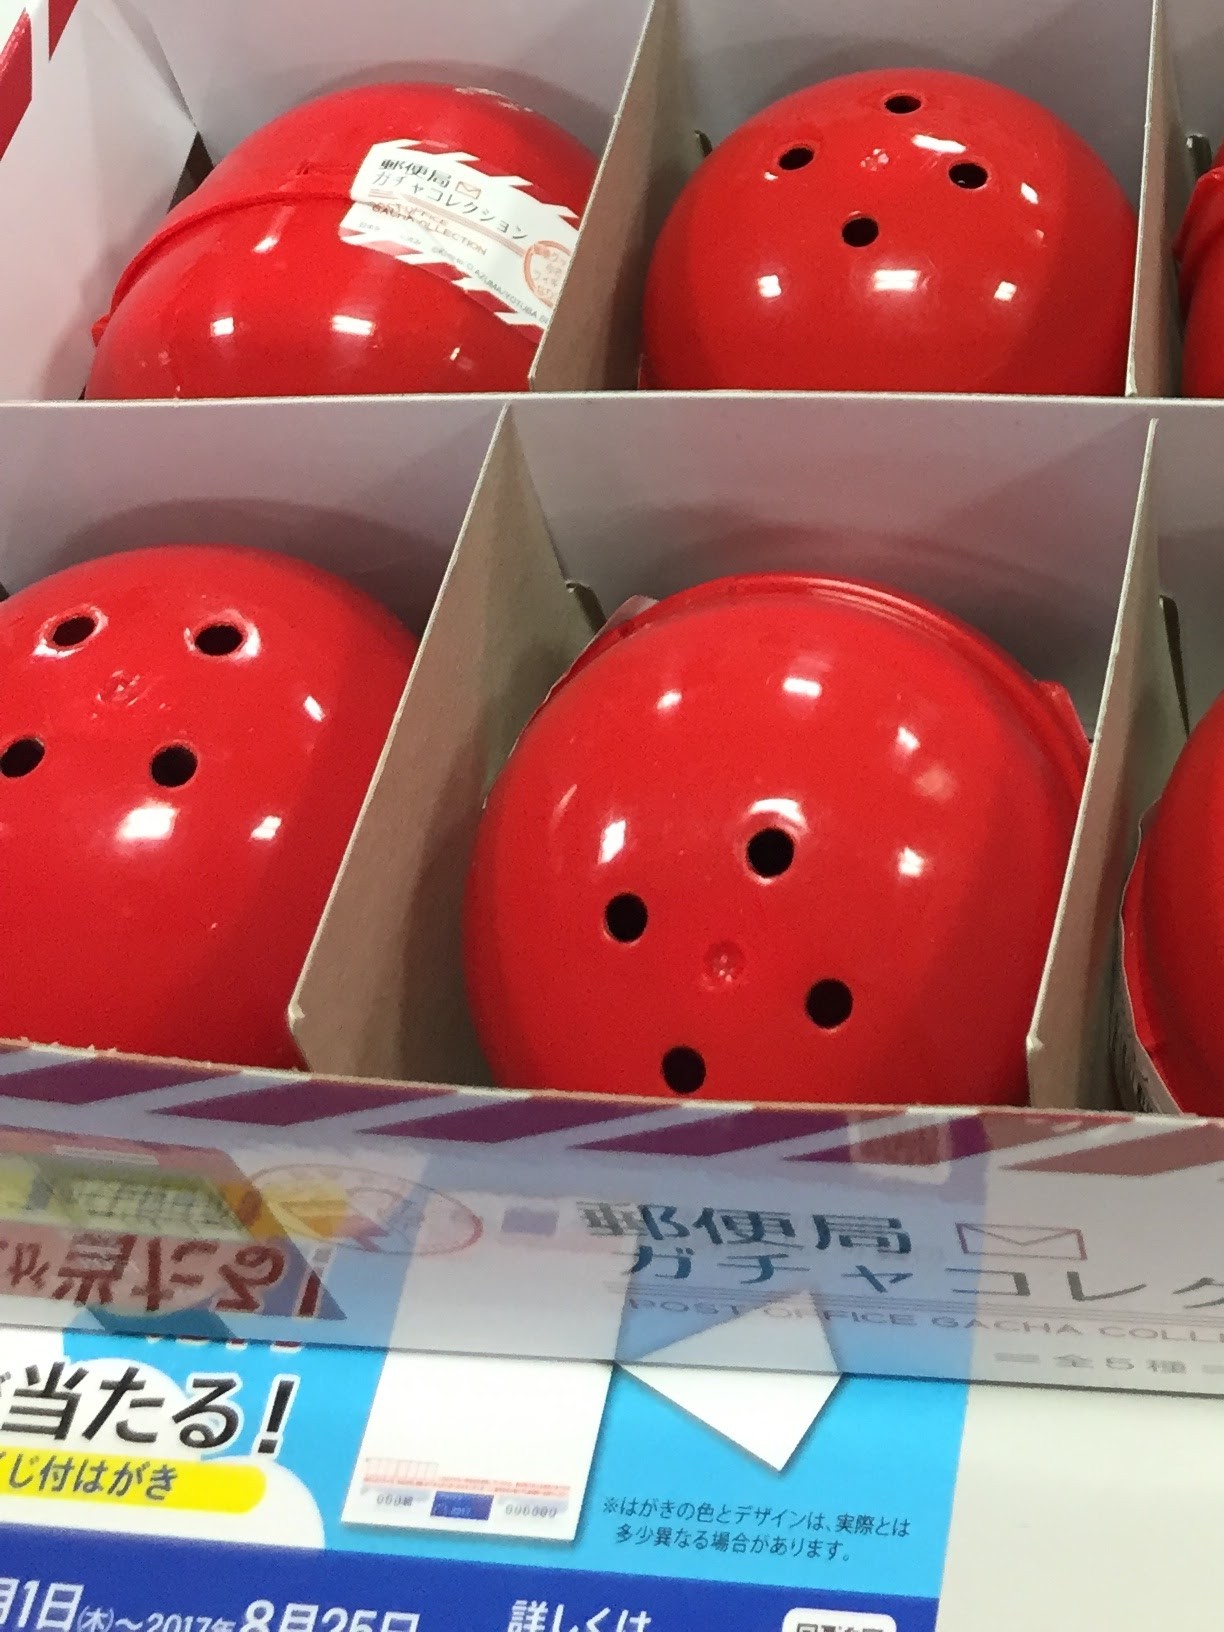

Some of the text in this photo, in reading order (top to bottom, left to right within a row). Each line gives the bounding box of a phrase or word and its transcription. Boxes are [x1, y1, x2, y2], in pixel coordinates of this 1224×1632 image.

[576, 1200, 913, 1256] 郵便局
[931, 1315, 1084, 1337] GACHA
[0, 1361, 294, 1454] 当たる!
[0, 1451, 178, 1501] じ付はがき
[615, 1522, 851, 1562] 多少異なる場合があります。
